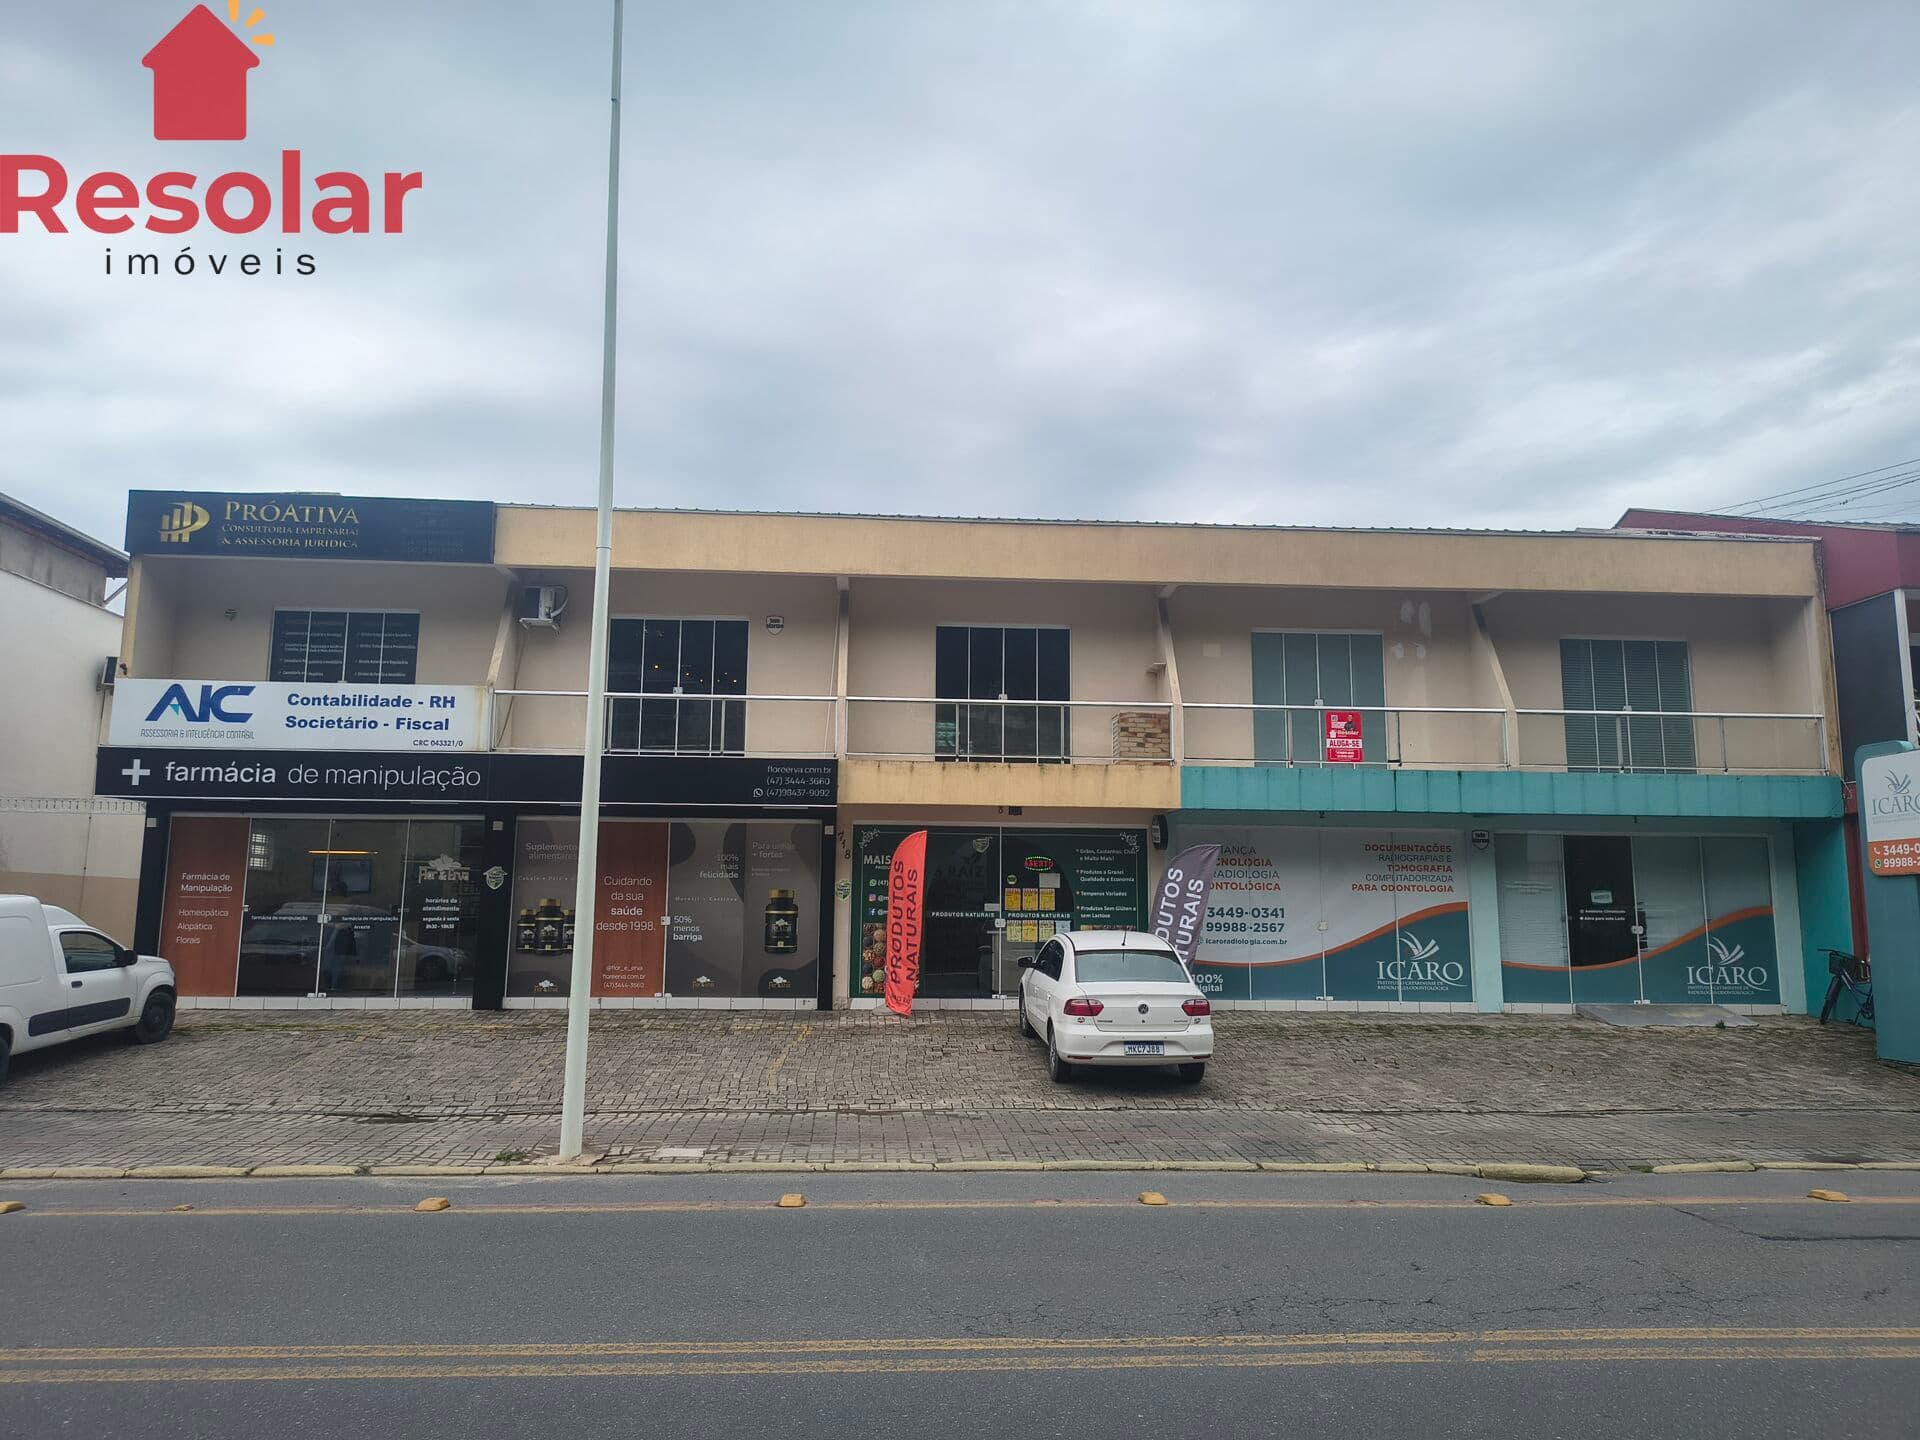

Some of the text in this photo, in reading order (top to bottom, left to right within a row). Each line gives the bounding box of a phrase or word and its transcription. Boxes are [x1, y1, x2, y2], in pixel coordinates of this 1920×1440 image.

[222, 524, 292, 534] CONSULTORIA
[234, 538, 300, 546] ASSESSORIA
[287, 693, 412, 708] Contabilidade
[430, 696, 456, 708] RH
[285, 715, 378, 731] Societário
[396, 717, 449, 731] Fiscal
[140, 729, 179, 737] ASSESSORIA
[165, 761, 481, 791] farmácia de manipulação
[766, 777, 783, 785] (47)
[526, 843, 578, 854] Suplemento
[1220, 846, 1256, 855] IANÇA
[1365, 843, 1452, 853] DOCUMENTAÇÕES
[863, 855, 892, 864] MAIS
[1378, 854, 1443, 862] RADIOGRAFIAS
[1387, 864, 1453, 873] TOMOGRAFIA
[603, 876, 652, 886] Cuidando
[1365, 874, 1453, 882] COMPUTADORIZADA
[181, 884, 233, 893] Manipulação
[1352, 884, 1454, 892] PARA ODONTOLOGIA
[611, 892, 623, 900] da
[1154, 868, 1183, 941] DUTOS
[178, 909, 229, 918] Homeopática
[611, 906, 643, 916] saúde
[1207, 907, 1285, 918] 3449-0341
[890, 860, 904, 984] PRODUTOS
[906, 869, 918, 981] NATURAIS
[1175, 879, 1204, 962] TURAIS
[177, 922, 212, 931] Alopática
[596, 922, 629, 931] desde
[1206, 922, 1285, 932] 99988-2567
[176, 936, 201, 944] Florais
[673, 933, 702, 941] barriga
[1376, 960, 1469, 986] ICARO
[1686, 966, 1771, 991] ICARO
[1200, 984, 1223, 993] igital
